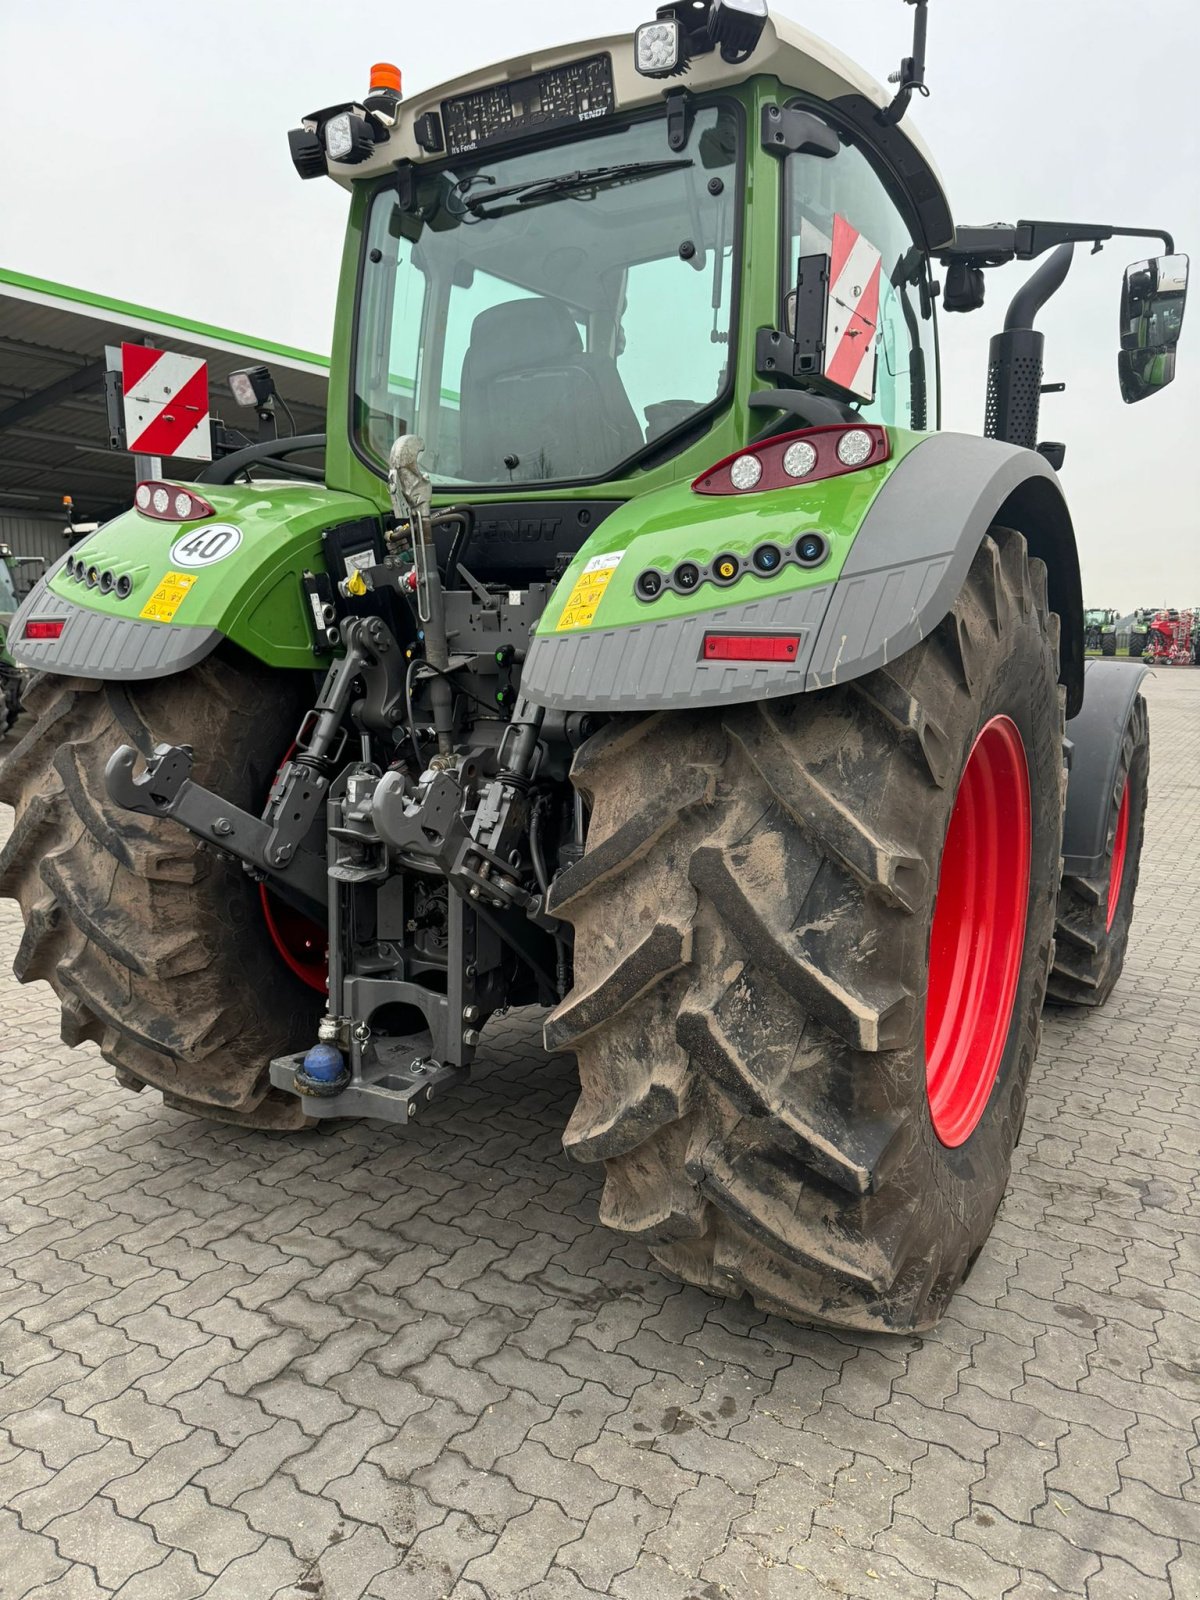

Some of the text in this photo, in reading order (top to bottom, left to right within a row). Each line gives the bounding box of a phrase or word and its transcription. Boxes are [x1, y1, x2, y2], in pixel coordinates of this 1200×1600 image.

[578, 106, 607, 121] FENDT
[451, 146, 460, 155] It's
[180, 529, 232, 558] 40
